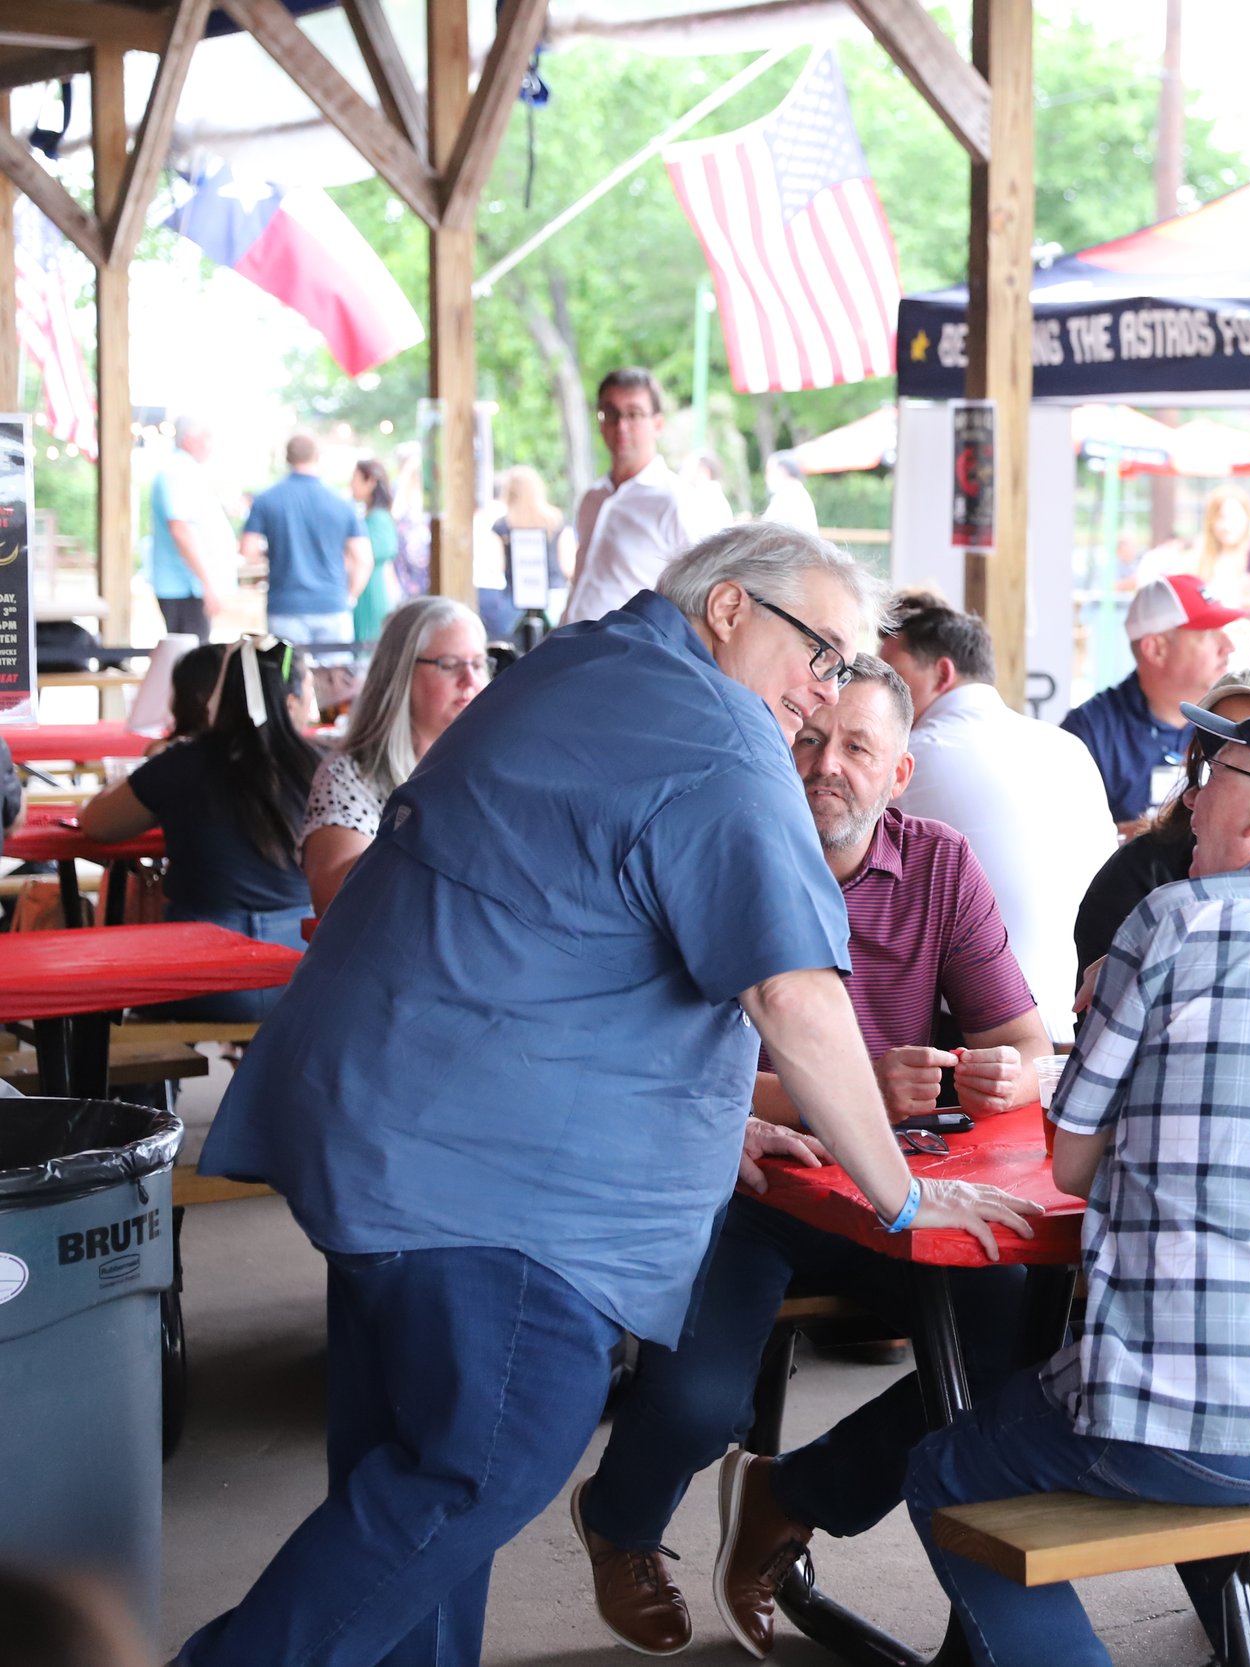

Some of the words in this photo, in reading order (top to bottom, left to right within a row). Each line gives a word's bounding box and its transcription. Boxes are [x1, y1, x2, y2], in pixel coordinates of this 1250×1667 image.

[1066, 313, 1115, 365] THE
[1119, 308, 1217, 361] ASTROS
[58, 1208, 161, 1266] BRUTE
